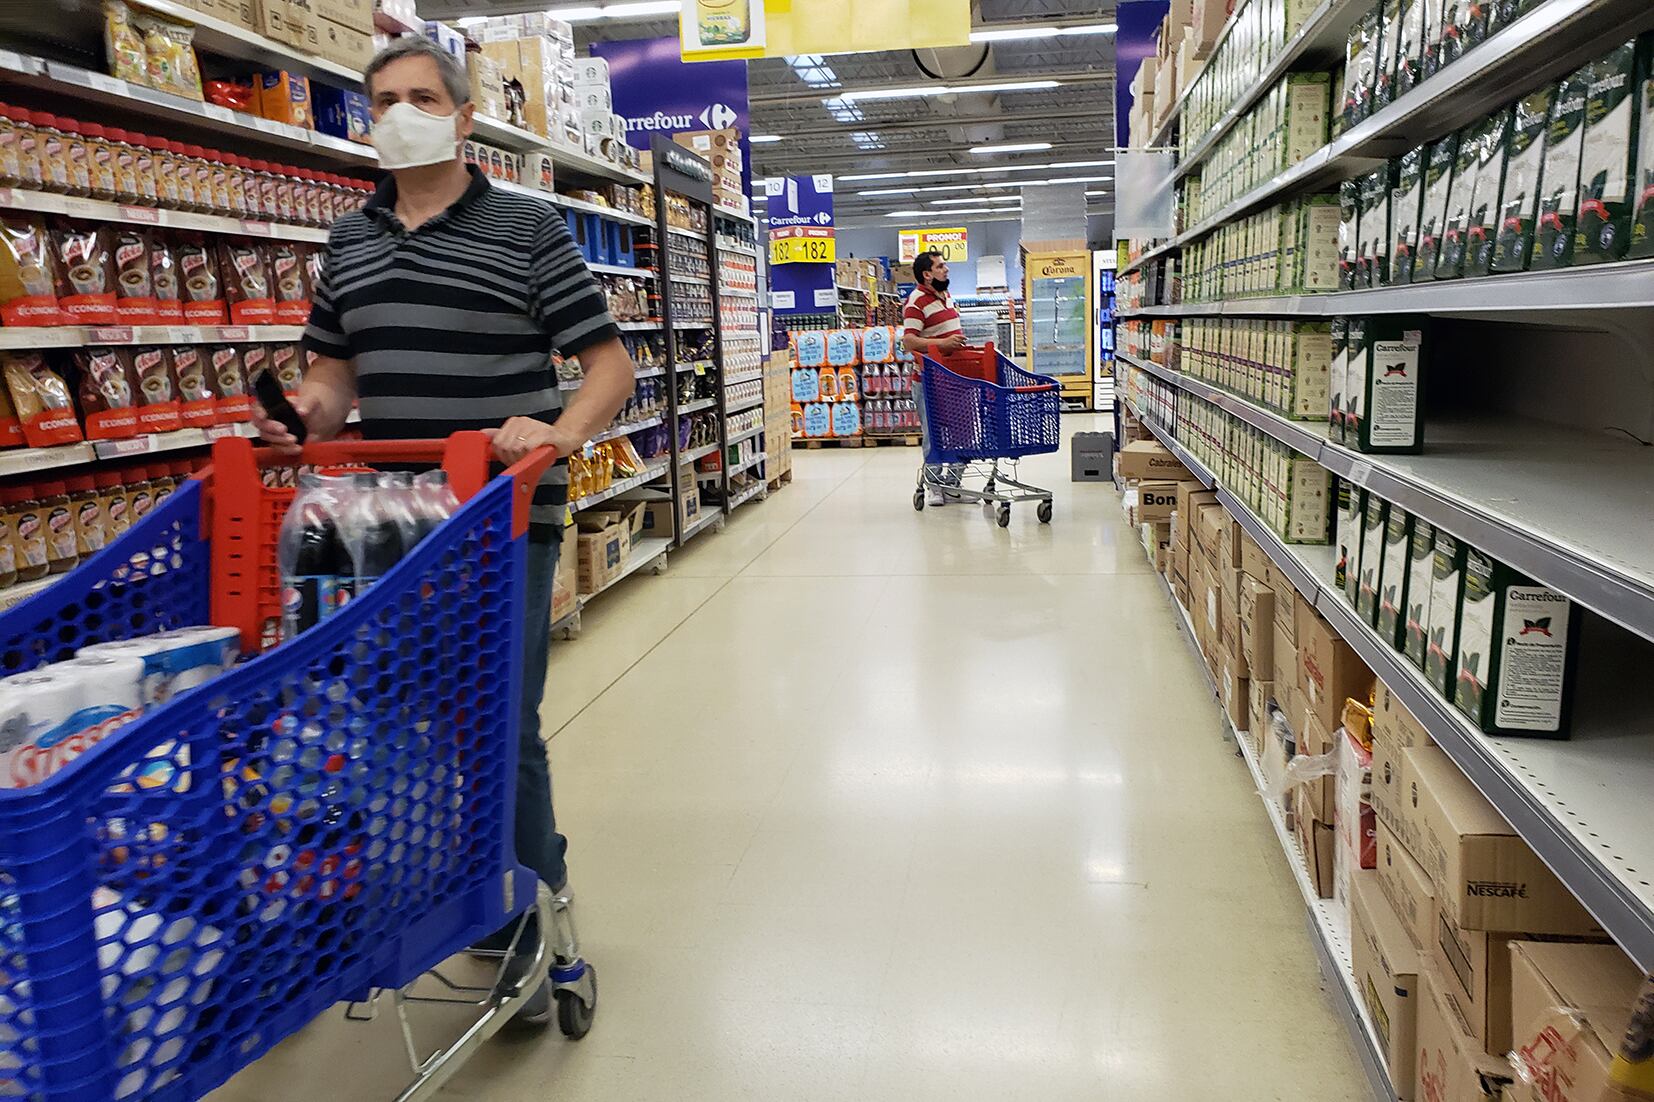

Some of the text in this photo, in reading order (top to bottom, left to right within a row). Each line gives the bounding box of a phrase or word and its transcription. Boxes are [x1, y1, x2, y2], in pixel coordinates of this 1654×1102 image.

[769, 182, 781, 192] 10
[818, 179, 829, 189] 12
[770, 216, 812, 226] Carrefour
[926, 233, 963, 242] PROMO!
[802, 241, 828, 260] 182
[1042, 266, 1076, 276] Corona
[1142, 493, 1177, 505] Bon
[1509, 590, 1567, 602] Carrefour
[1466, 883, 1527, 899] NESCAFÉ
